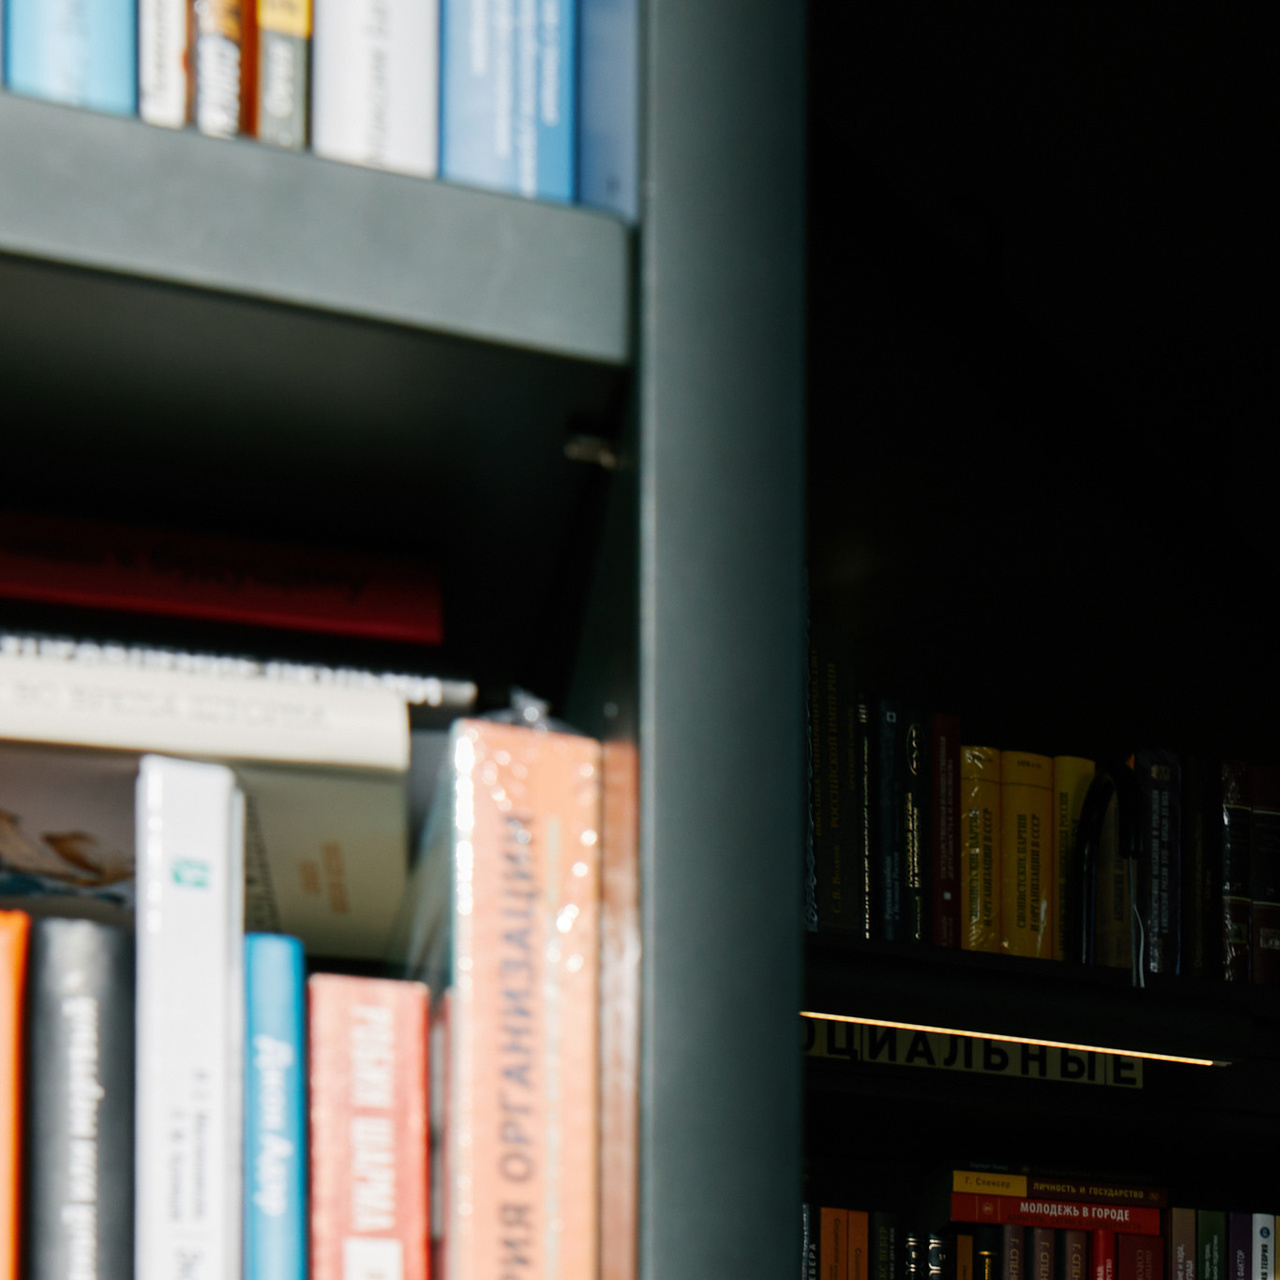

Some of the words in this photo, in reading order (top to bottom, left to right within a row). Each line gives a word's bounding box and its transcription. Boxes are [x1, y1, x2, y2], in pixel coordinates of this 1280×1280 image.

[499, 810, 538, 1184] ОРГАНИЗАЦИИ
[254, 1036, 295, 1110] Джон
[350, 1005, 397, 1108] РОБИН
[254, 1131, 295, 1220] Адэр
[350, 1118, 397, 1231] ШАРМА
[1020, 1202, 1080, 1218] МОЛОДЕЖЬ
[1082, 1206, 1089, 1217] В
[1091, 1207, 1130, 1221] ГОРОДЕ
[1033, 1182, 1076, 1194] ЛИЧНОСТЬ
[1089, 1186, 1144, 1199] ГОСУДАРСТВО
